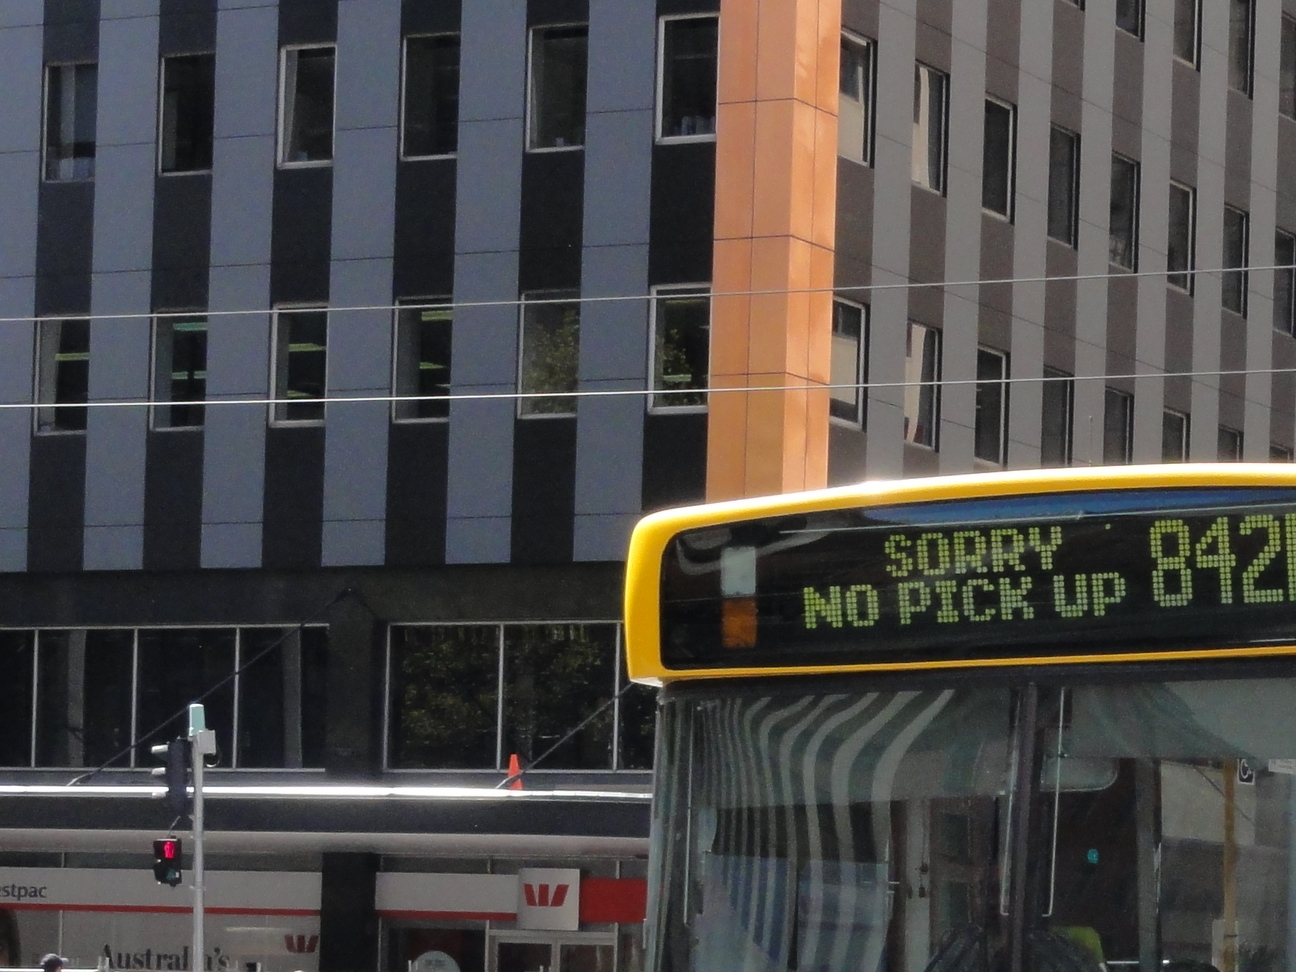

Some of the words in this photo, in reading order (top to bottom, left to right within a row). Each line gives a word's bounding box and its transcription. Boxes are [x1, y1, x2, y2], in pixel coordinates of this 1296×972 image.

[883, 526, 1063, 577] SORRY
[803, 583, 879, 629] NO
[899, 576, 1034, 624] PICK
[1053, 571, 1127, 618] UP
[0, 884, 47, 901] stpac
